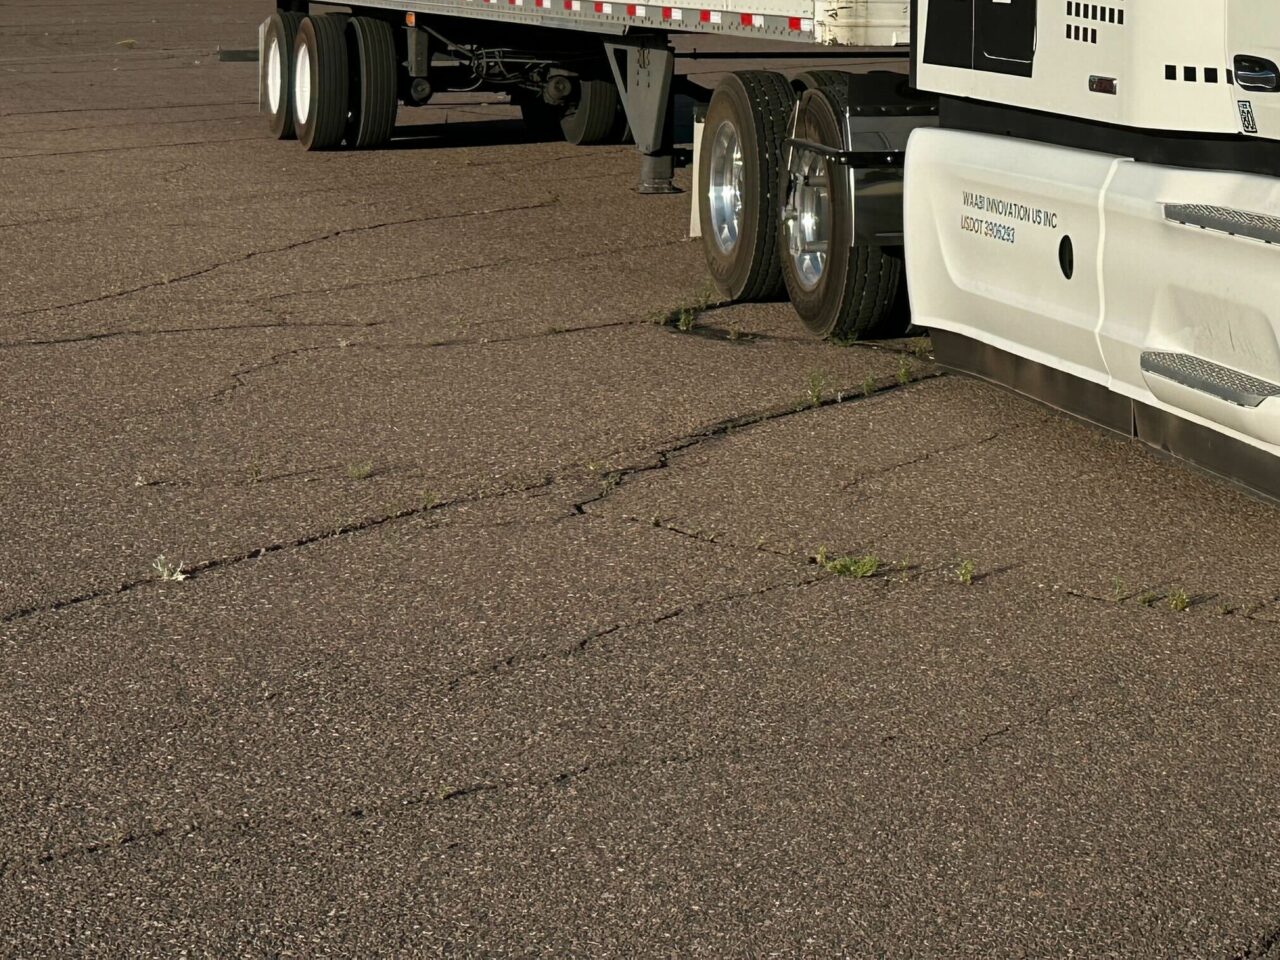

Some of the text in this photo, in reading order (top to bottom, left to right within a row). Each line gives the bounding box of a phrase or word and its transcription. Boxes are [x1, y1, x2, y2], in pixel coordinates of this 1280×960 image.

[963, 191, 1058, 228] WAABI INNOVATION US INC
[961, 214, 984, 235] USDOT
